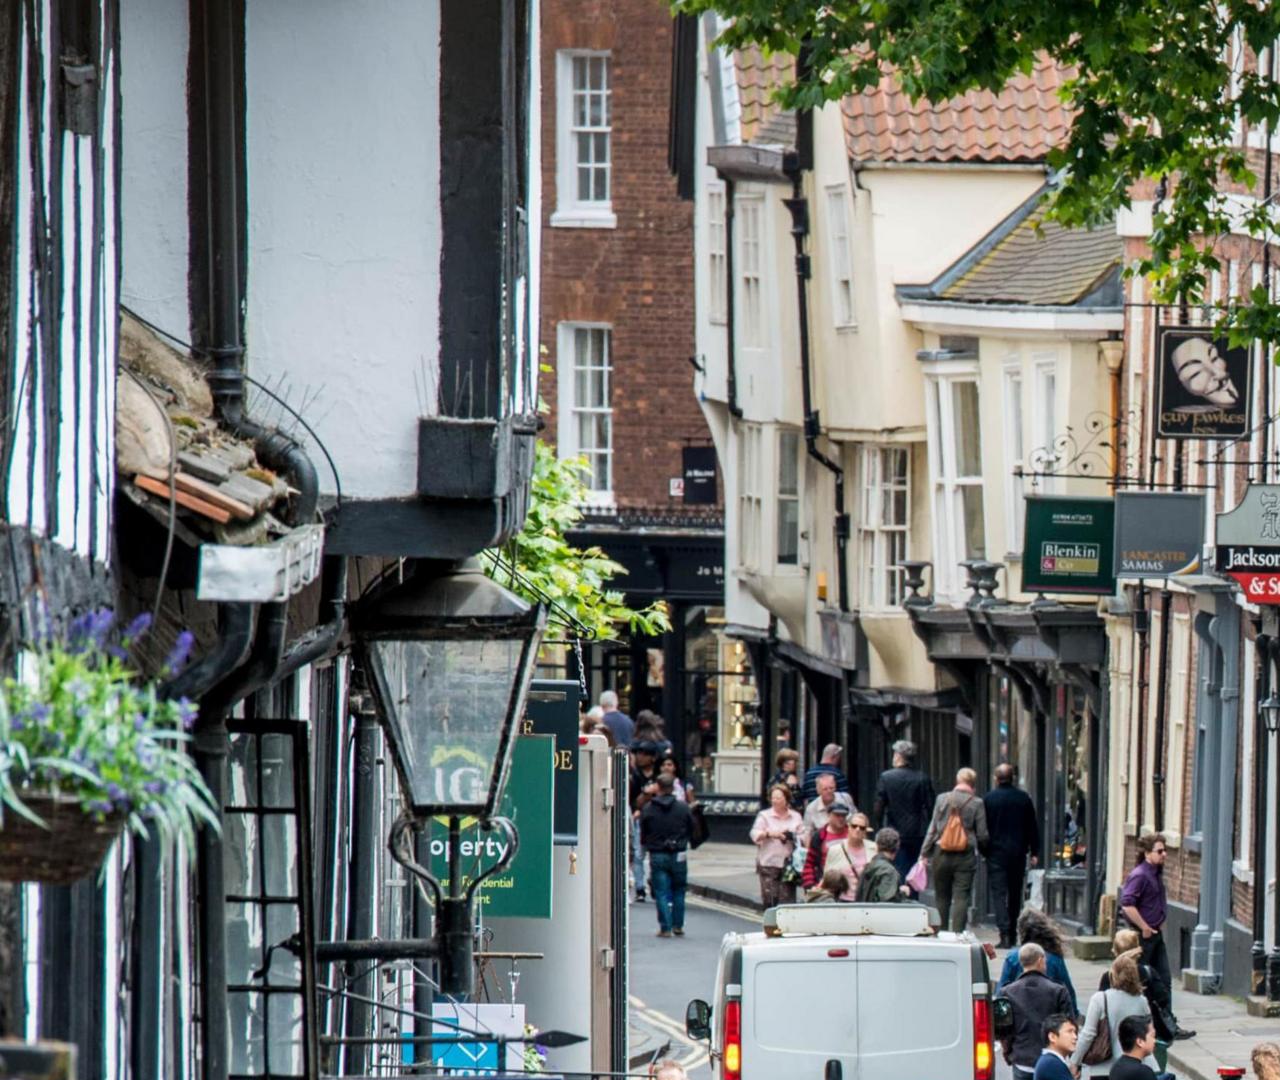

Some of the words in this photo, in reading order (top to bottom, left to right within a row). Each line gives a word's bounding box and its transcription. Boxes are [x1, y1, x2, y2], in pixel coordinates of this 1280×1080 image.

[1045, 544, 1096, 557] Blenkin
[1121, 551, 1186, 561] LANCASTER
[1058, 560, 1074, 569] Co
[1121, 560, 1164, 570] SAMMS
[1249, 577, 1265, 594] &
